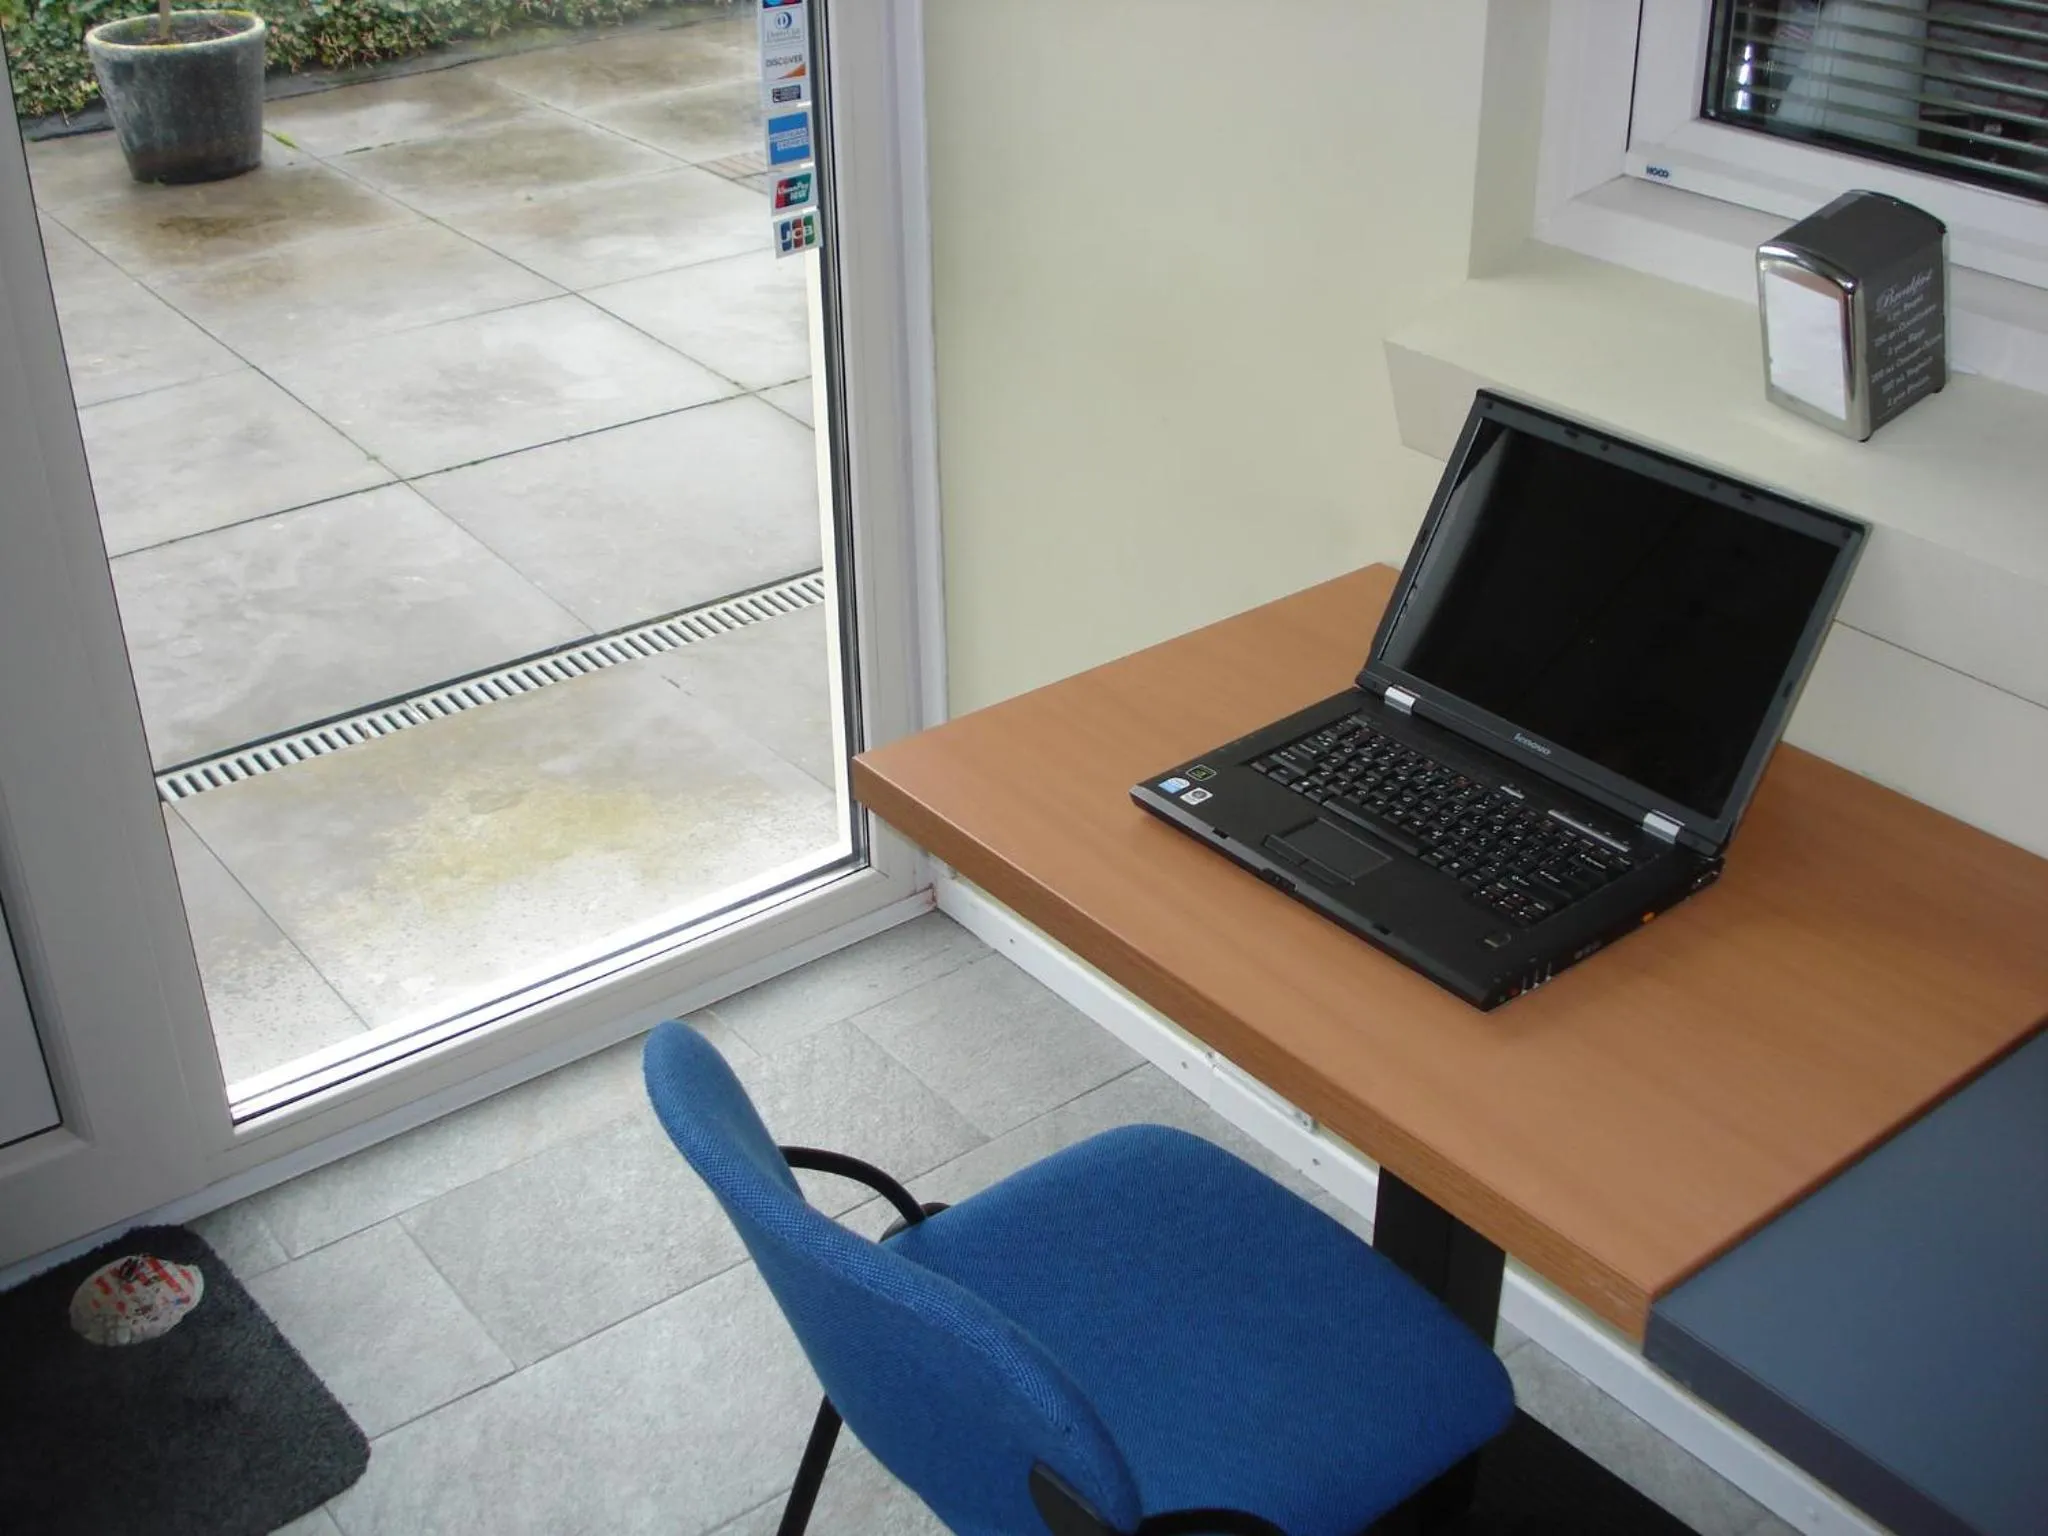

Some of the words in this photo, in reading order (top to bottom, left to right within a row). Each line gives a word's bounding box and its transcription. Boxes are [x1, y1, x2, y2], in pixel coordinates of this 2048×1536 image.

[766, 53, 803, 68] DISCOVER
[781, 224, 812, 242] JCB
[1514, 732, 1551, 756] lenovo
